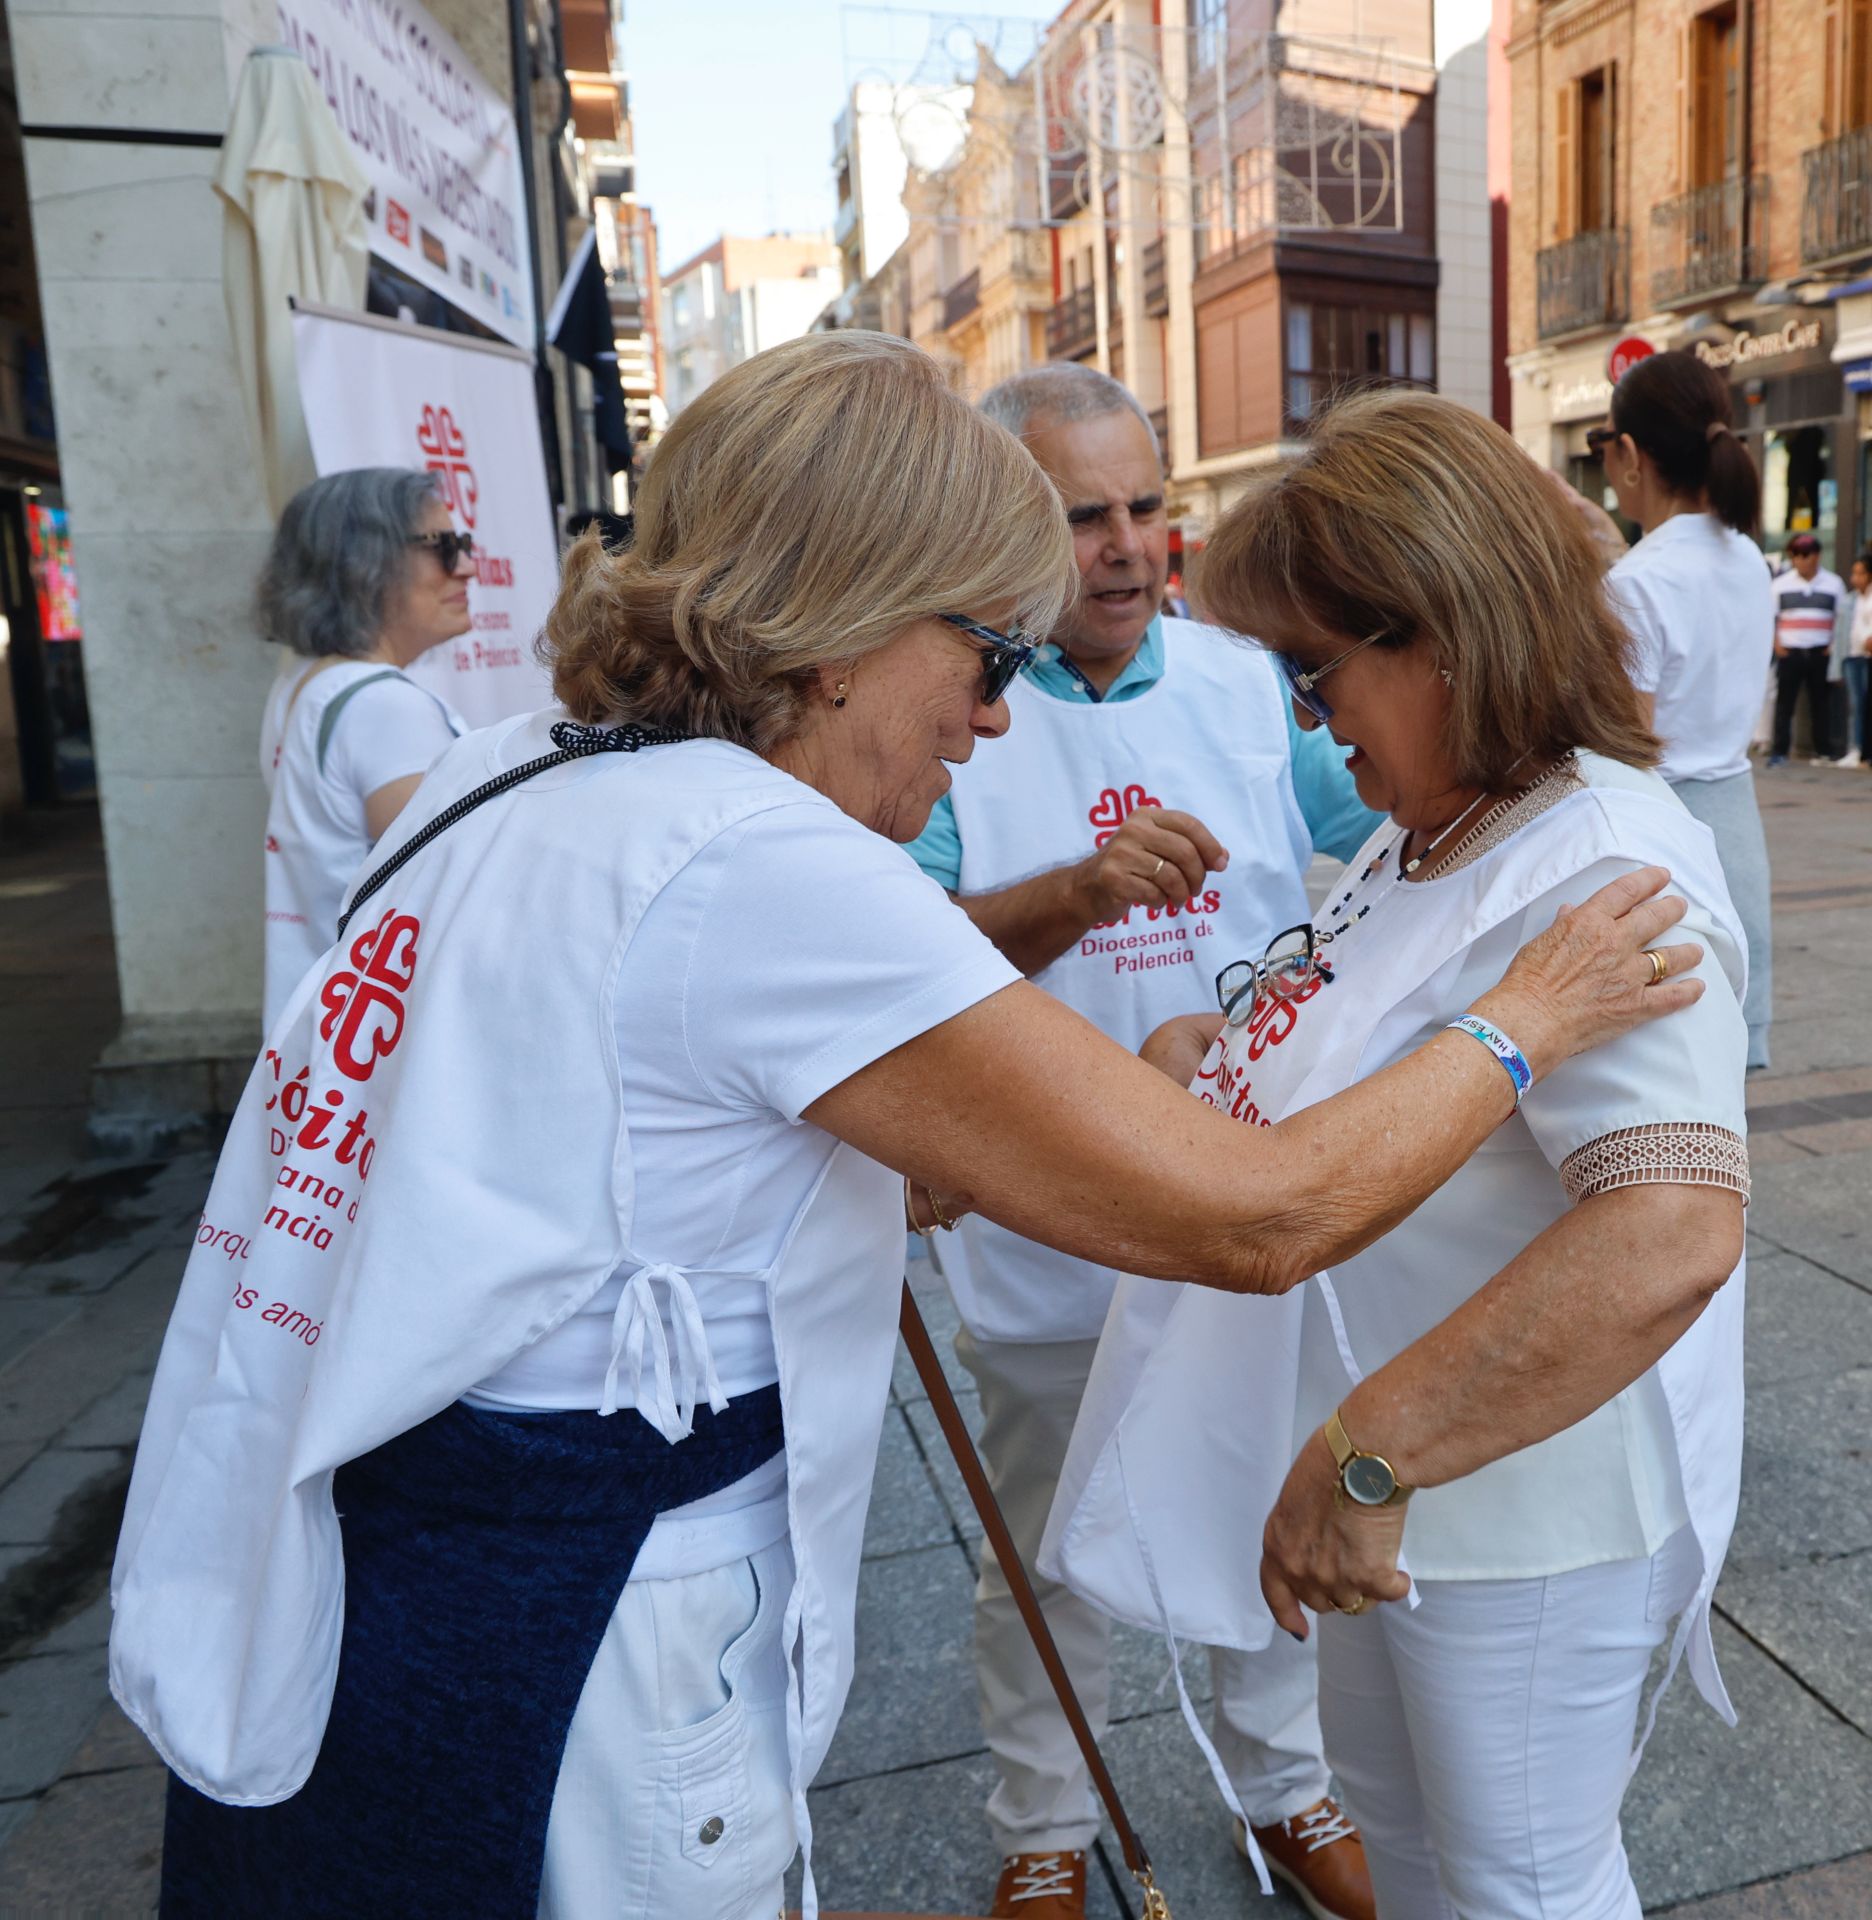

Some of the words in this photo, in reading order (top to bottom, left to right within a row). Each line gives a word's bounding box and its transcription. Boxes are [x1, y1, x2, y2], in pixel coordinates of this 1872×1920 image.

[1081, 927, 1187, 957] Diocesana
[1114, 947, 1195, 975] Palencia
[1486, 1031, 1509, 1053] HAY
[260, 1301, 325, 1346] amó
